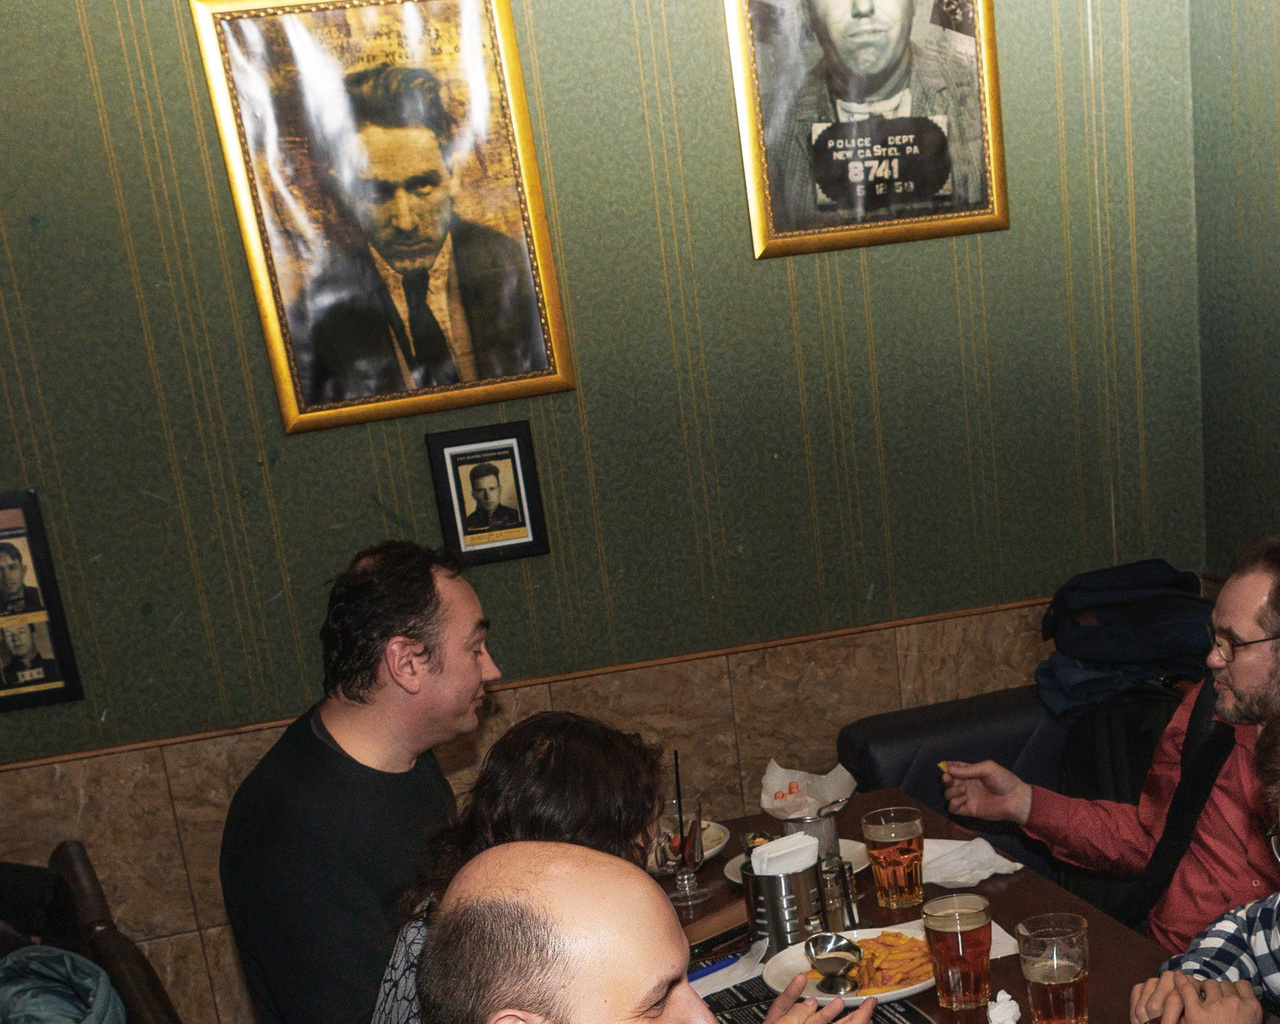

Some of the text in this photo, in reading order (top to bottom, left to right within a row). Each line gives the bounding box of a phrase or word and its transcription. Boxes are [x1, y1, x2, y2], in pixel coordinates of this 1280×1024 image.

[827, 134, 915, 149] POLICE DEPT
[832, 149, 854, 160] NEW
[905, 145, 920, 155] PA
[847, 158, 899, 182] 8741
